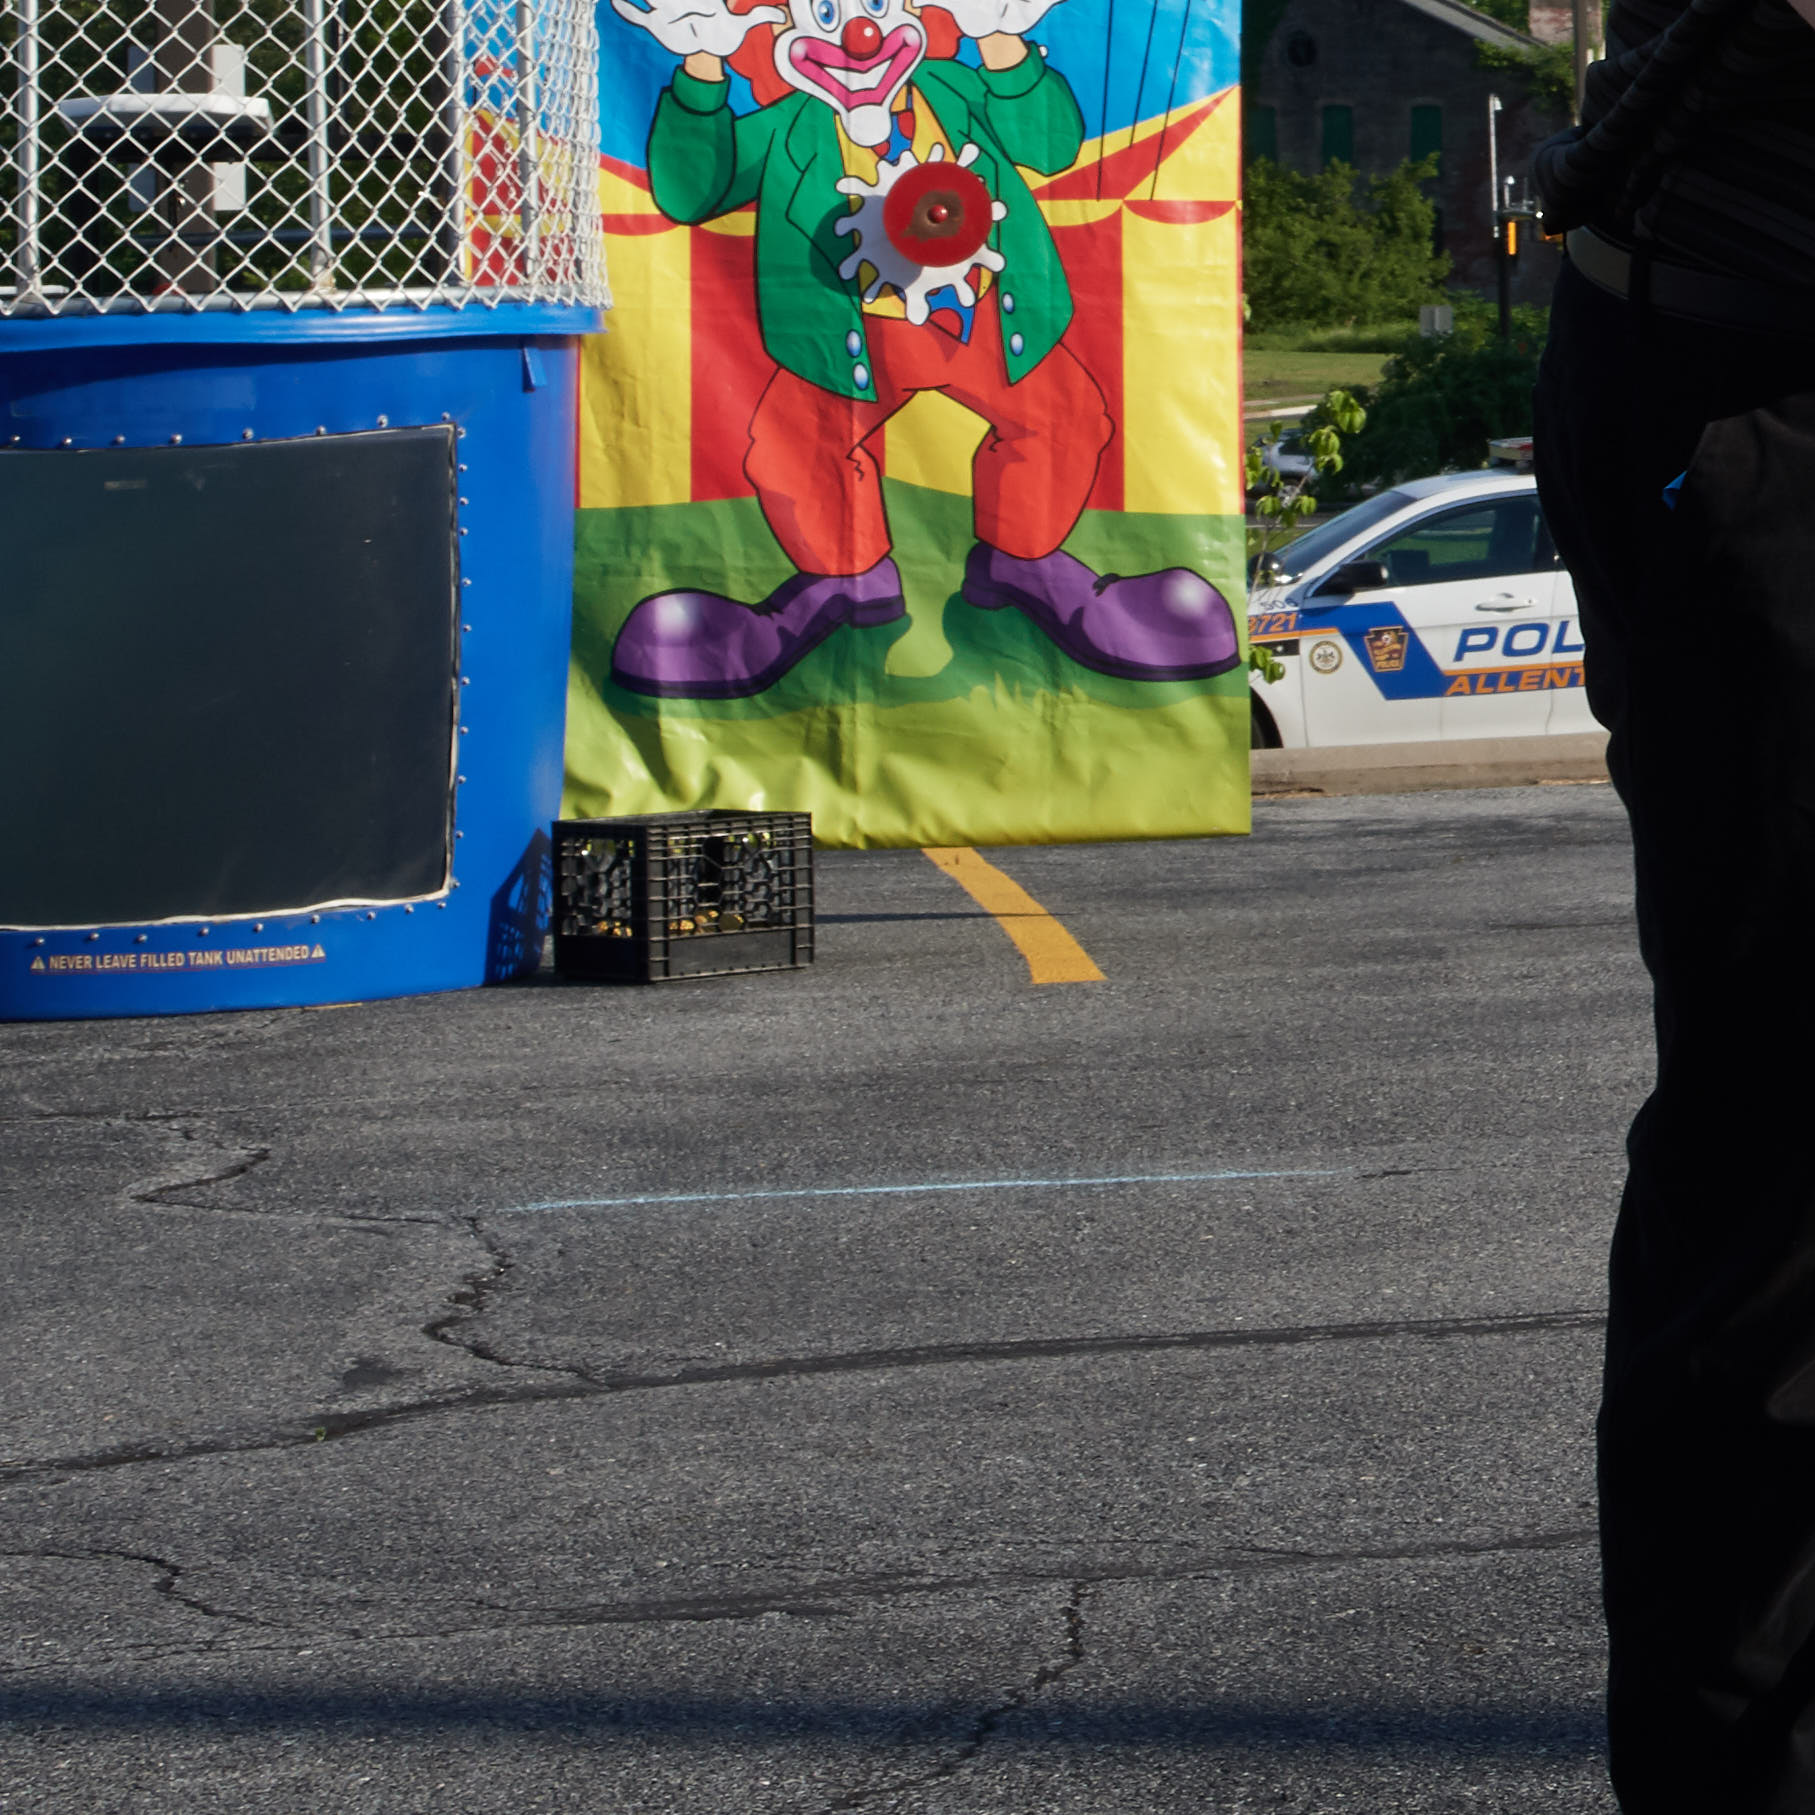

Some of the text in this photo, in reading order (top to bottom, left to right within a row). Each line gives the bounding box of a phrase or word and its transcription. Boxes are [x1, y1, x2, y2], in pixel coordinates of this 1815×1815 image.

[49, 945, 310, 970] NEVER LEAVE FILLED TANK UNATTENDED
